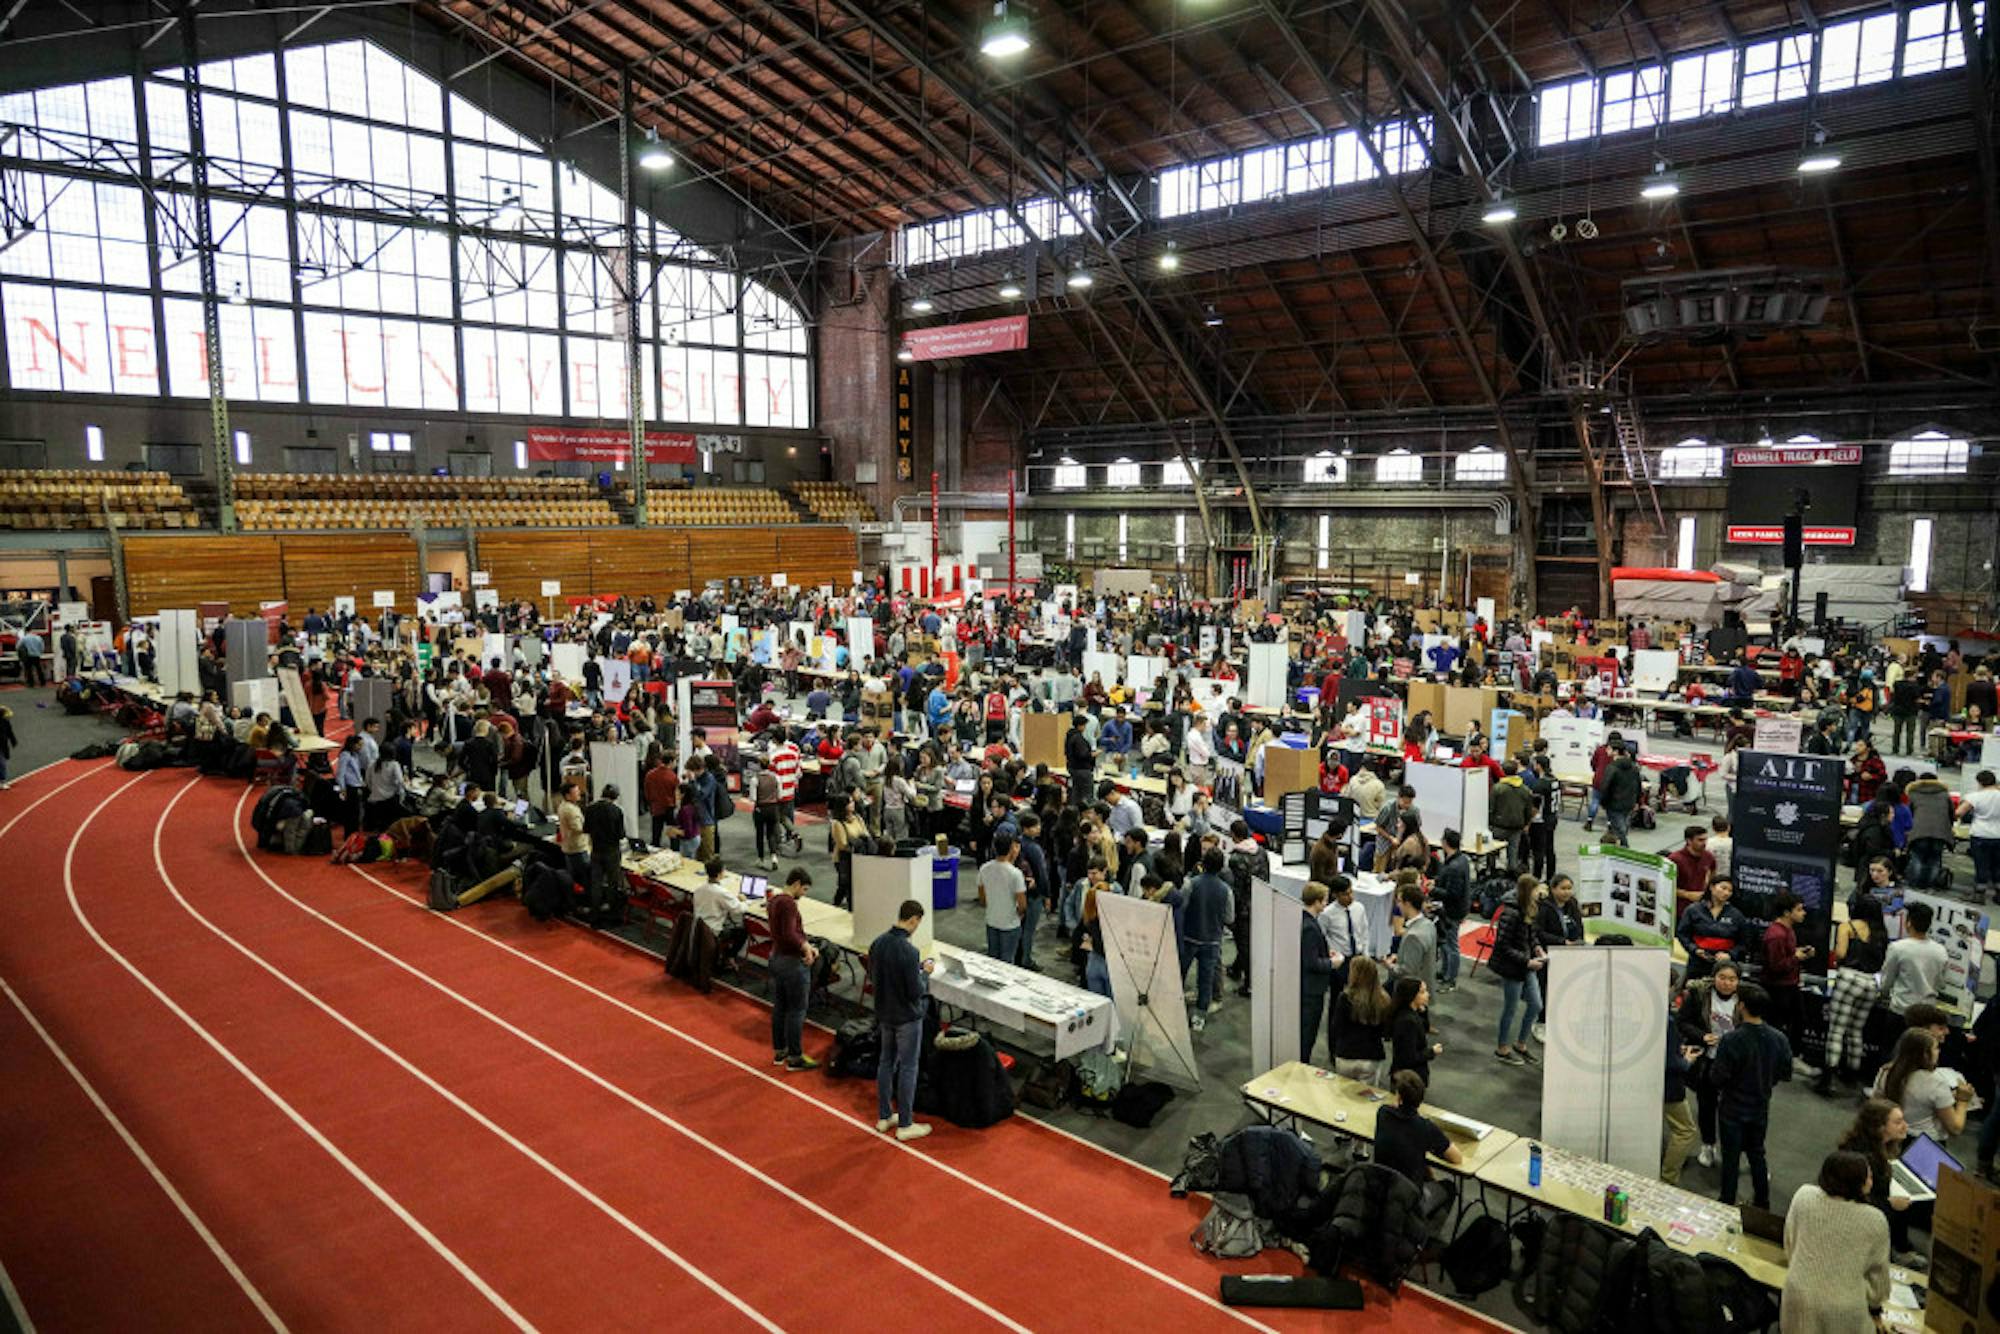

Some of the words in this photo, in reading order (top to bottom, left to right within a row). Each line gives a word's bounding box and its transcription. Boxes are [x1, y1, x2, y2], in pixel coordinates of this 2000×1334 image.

[1737, 451, 1781, 463] CORNELL
[1783, 450, 1814, 462] TRACK
[1828, 449, 1858, 461] FIELD
